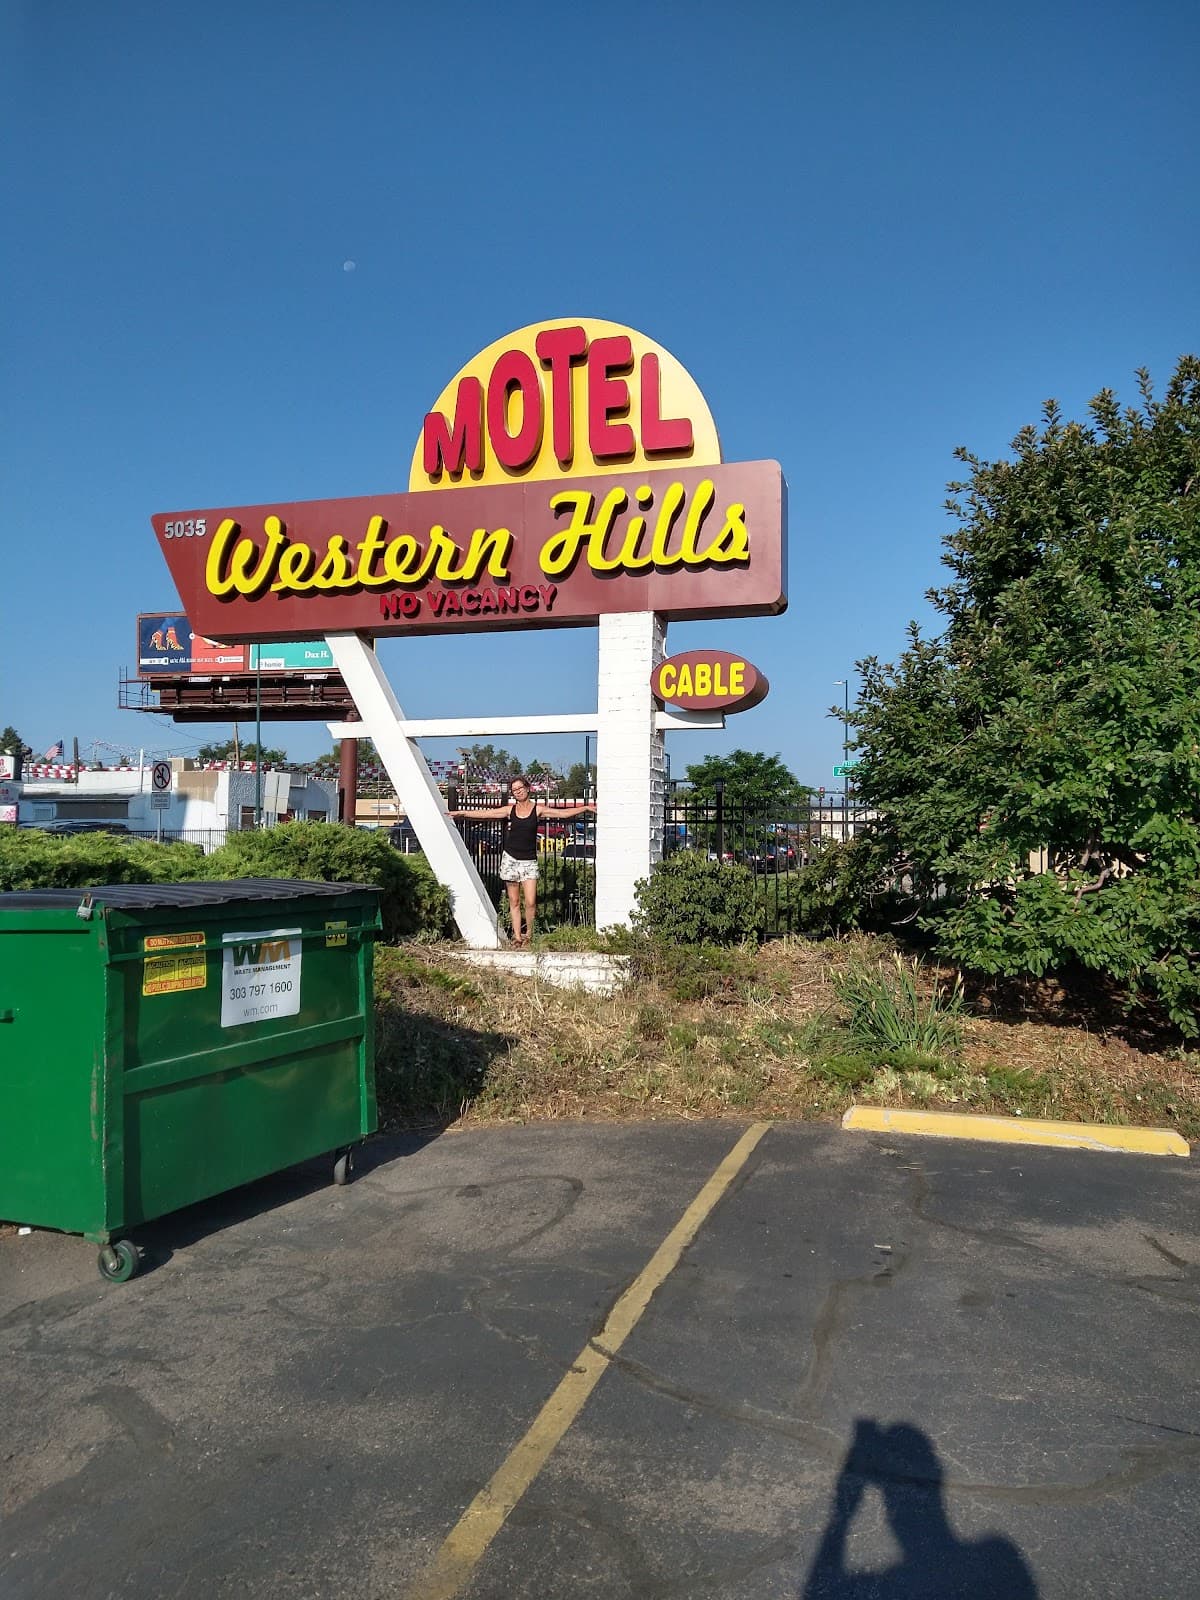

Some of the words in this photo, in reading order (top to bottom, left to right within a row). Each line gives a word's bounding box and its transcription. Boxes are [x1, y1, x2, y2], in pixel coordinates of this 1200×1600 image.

[424, 325, 694, 475] MOTEL
[164, 518, 207, 539] 5035
[204, 515, 508, 596] Western
[539, 479, 750, 575] Hills
[380, 593, 419, 617] NO
[427, 584, 556, 613] VACANCY
[659, 662, 745, 698] CABLE
[232, 941, 291, 967] WM
[234, 967, 252, 976] WASTE
[253, 963, 292, 973] MANAGEMENT
[230, 987, 247, 1000] 303
[249, 984, 266, 997] 797
[270, 980, 293, 993] 1600
[243, 1004, 279, 1016] wm.com
